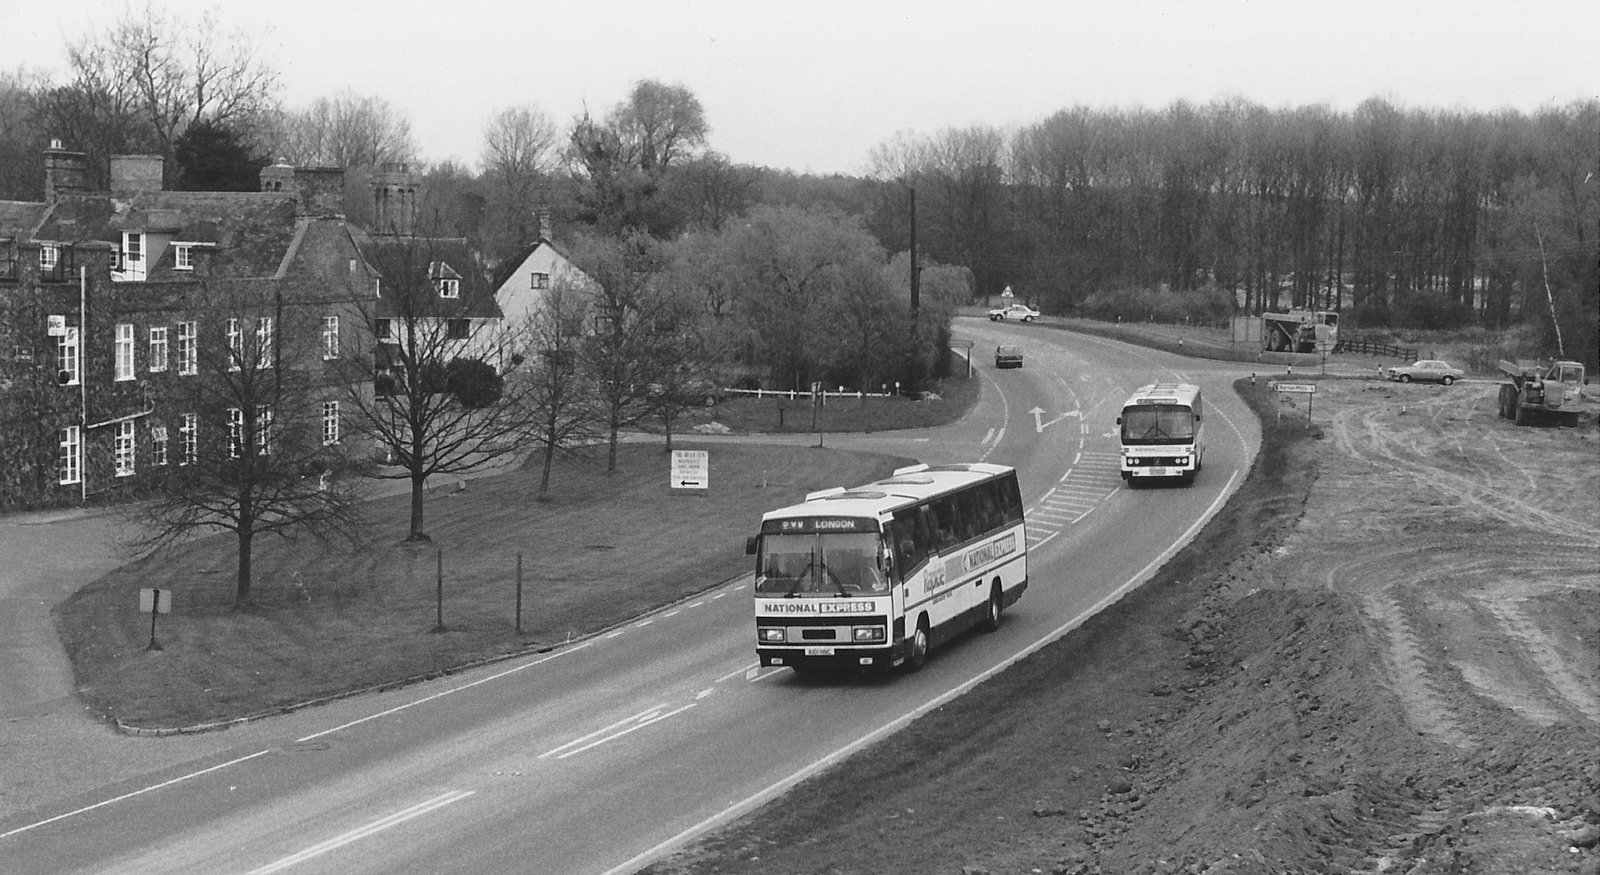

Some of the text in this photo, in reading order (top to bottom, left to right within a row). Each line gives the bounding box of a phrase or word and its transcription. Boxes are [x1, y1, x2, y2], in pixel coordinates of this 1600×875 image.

[815, 520, 854, 529] LONDON
[969, 543, 994, 569] NATIONAL
[764, 602, 873, 613] NATIONAL EXPRESS
